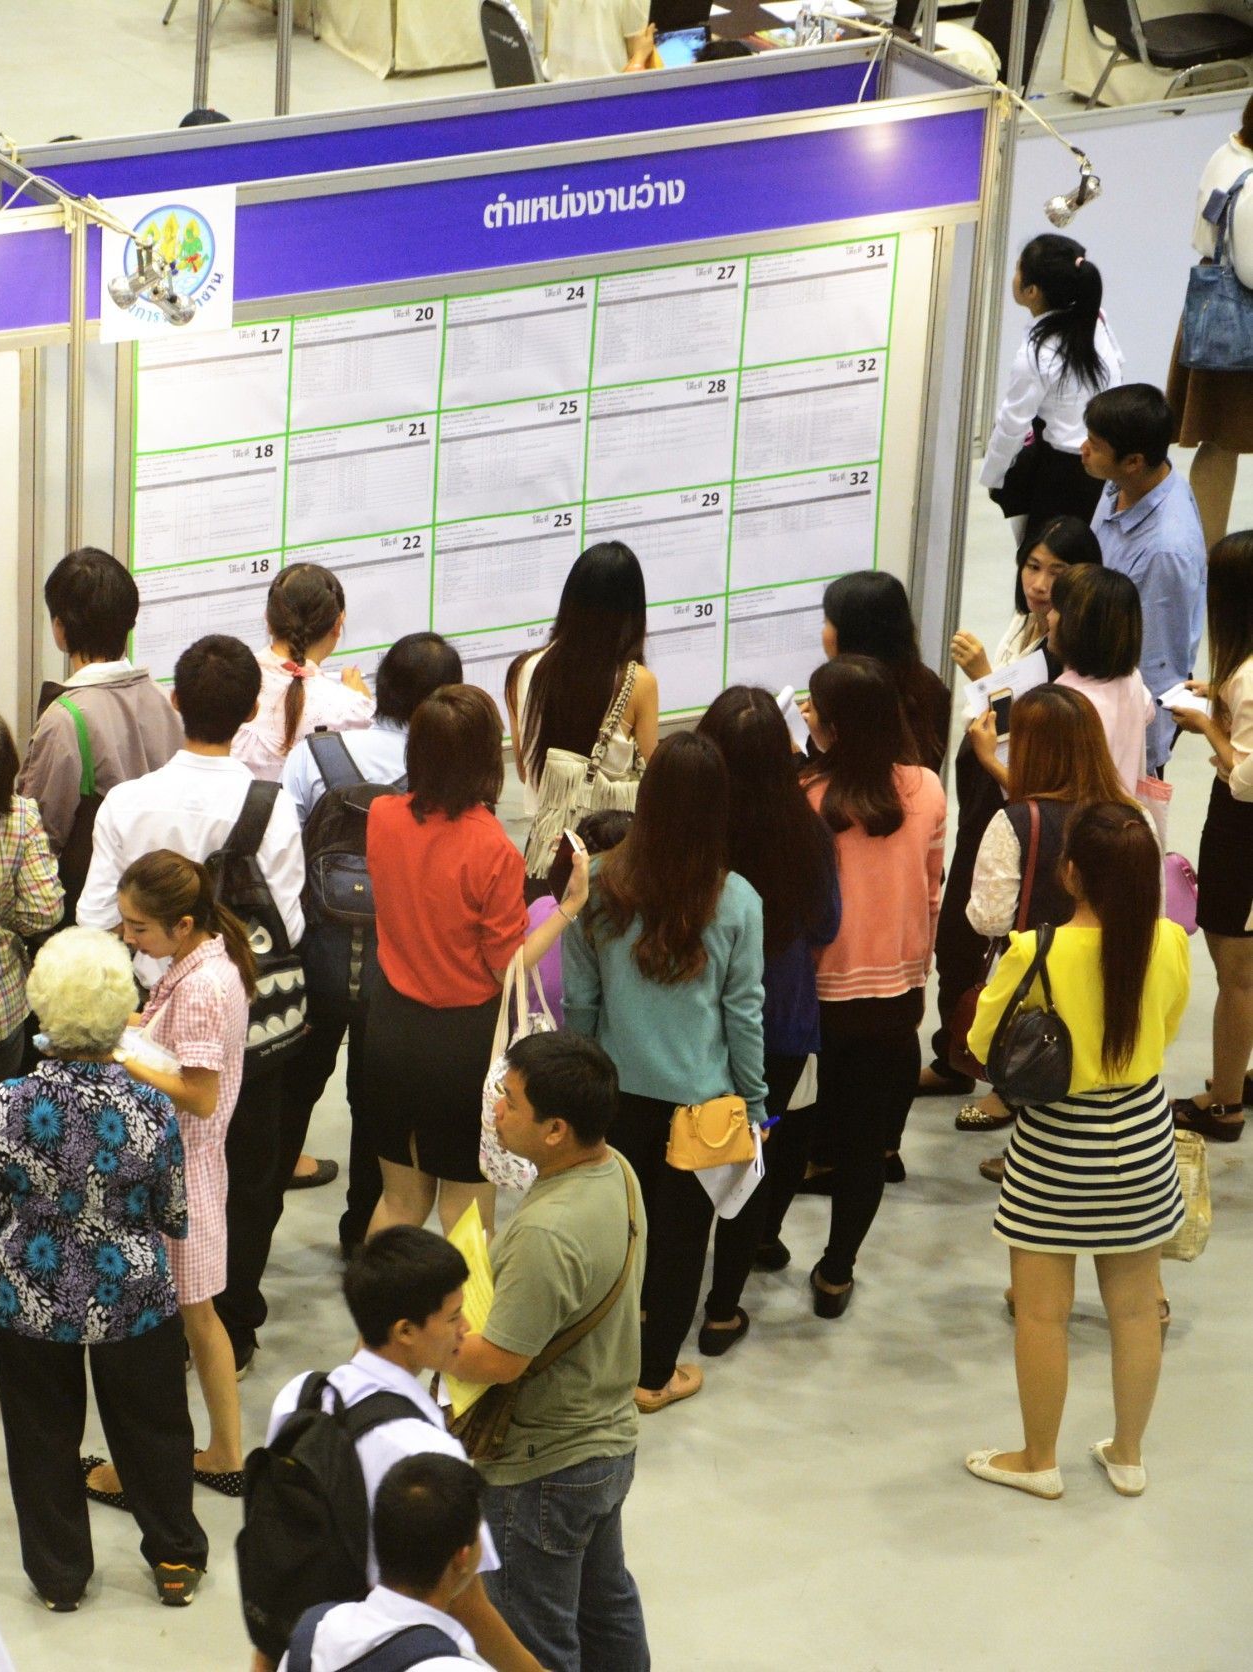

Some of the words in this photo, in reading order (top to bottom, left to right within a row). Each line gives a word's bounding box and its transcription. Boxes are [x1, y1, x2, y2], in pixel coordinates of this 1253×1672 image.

[483, 174, 686, 229] ตำแหน่งงานว่าง
[866, 243, 884, 259] 31
[716, 264, 736, 281] 27
[566, 285, 585, 301] 24
[415, 306, 434, 322] 20
[261, 327, 281, 343] 17
[857, 357, 877, 373] 32
[707, 379, 726, 394] 28
[558, 399, 578, 416] 25
[408, 422, 427, 437] 21
[254, 443, 274, 459] 18
[849, 470, 869, 486] 32
[701, 492, 720, 507] 29
[553, 512, 572, 528] 25
[402, 535, 421, 551] 22
[251, 558, 270, 574] 18
[694, 602, 713, 618] 30
